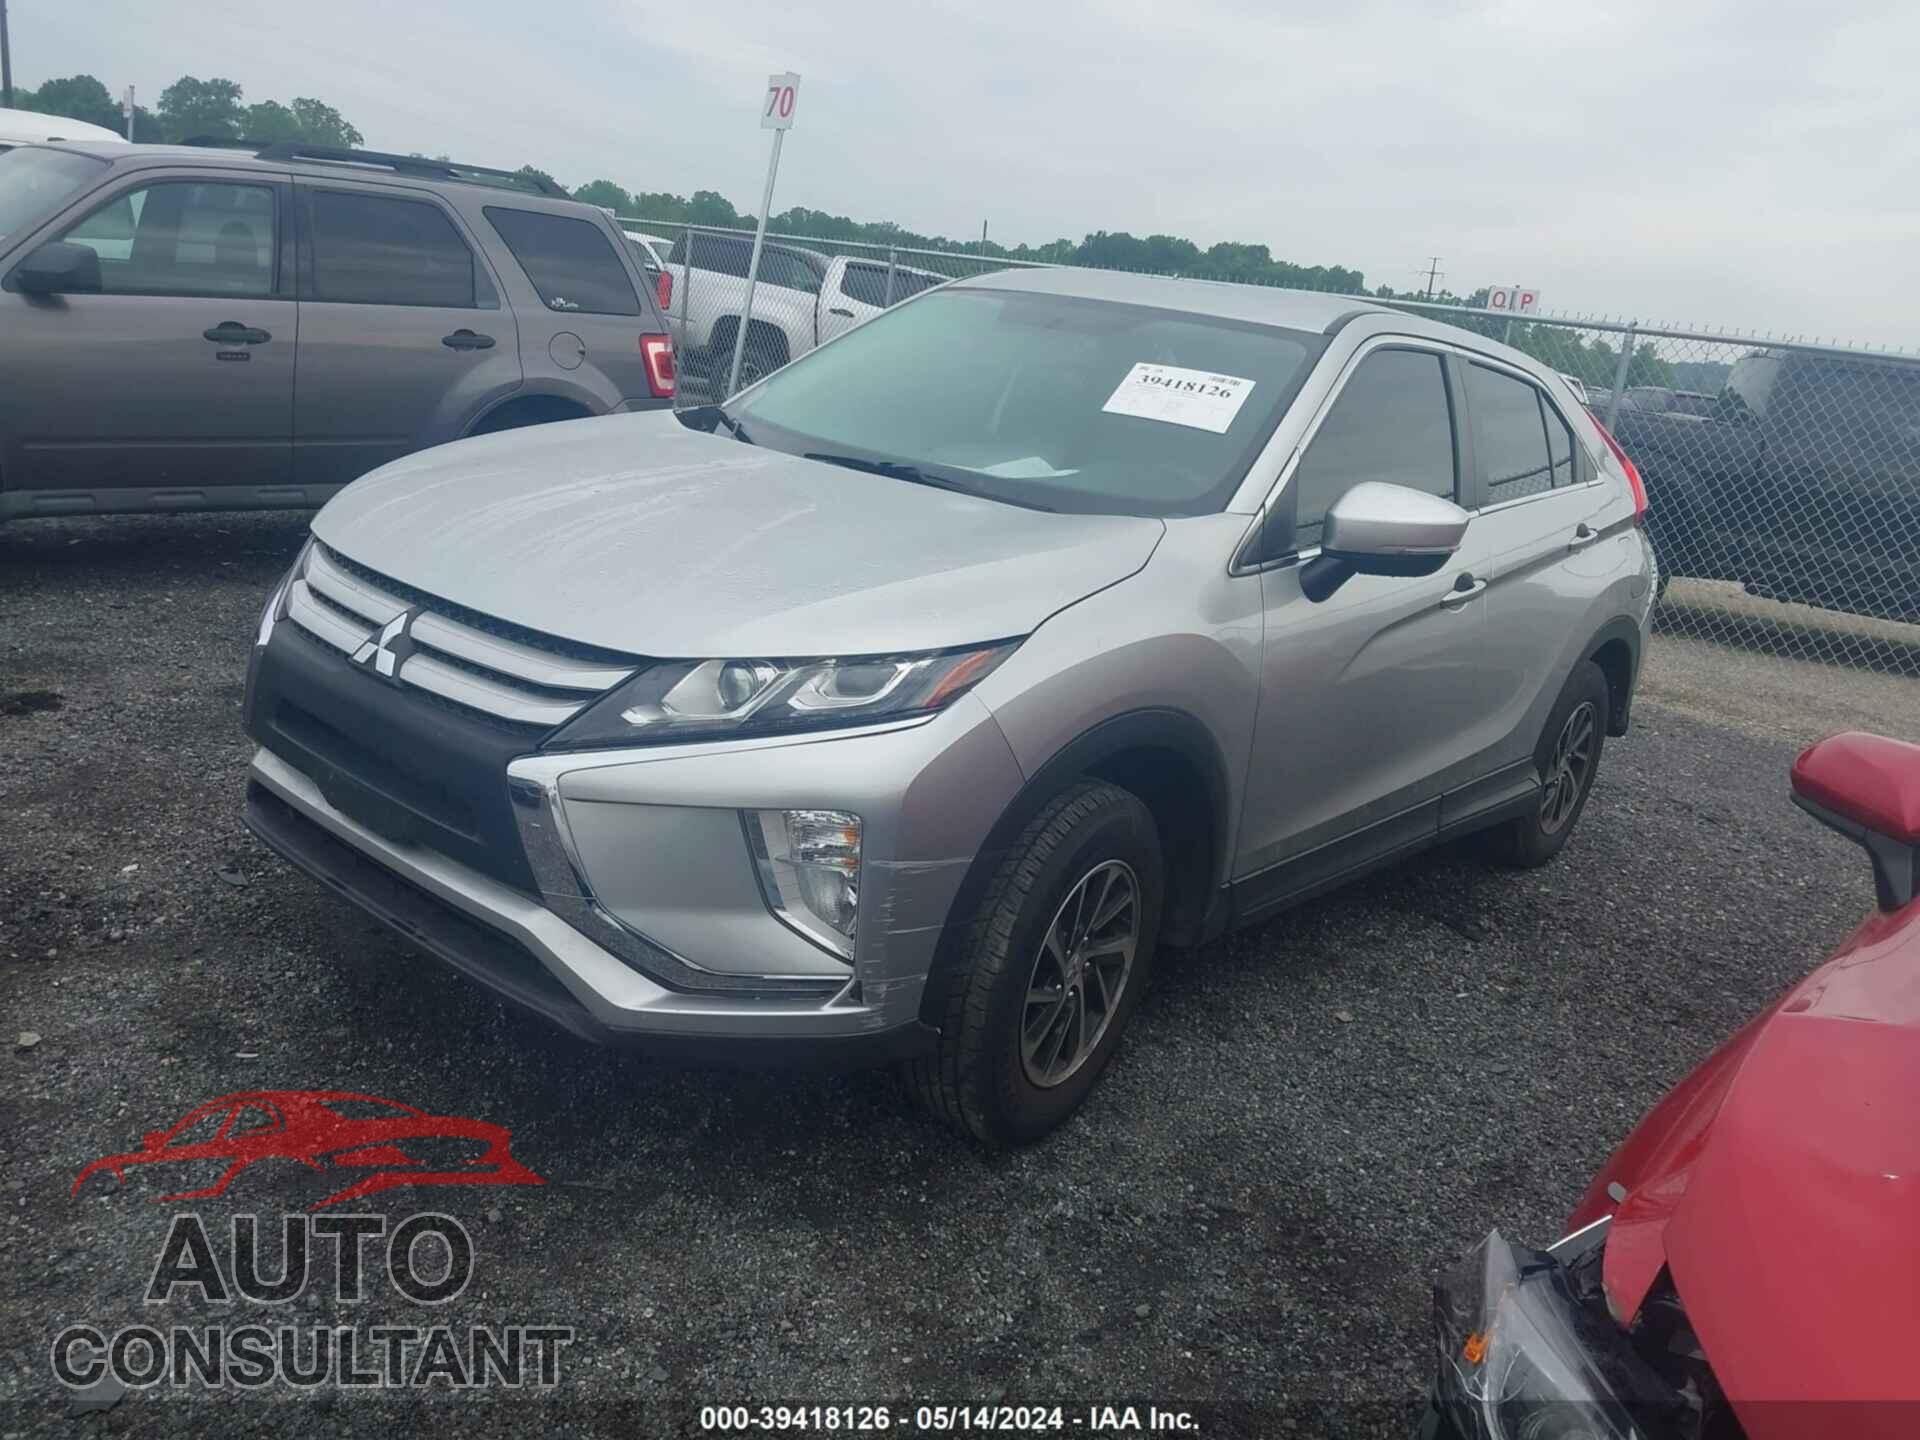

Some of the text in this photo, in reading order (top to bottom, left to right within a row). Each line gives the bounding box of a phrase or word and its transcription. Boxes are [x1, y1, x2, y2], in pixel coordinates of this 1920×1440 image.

[766, 86, 794, 118] 70
[1492, 291, 1533, 309] Q P
[1136, 374, 1231, 399] 39418126
